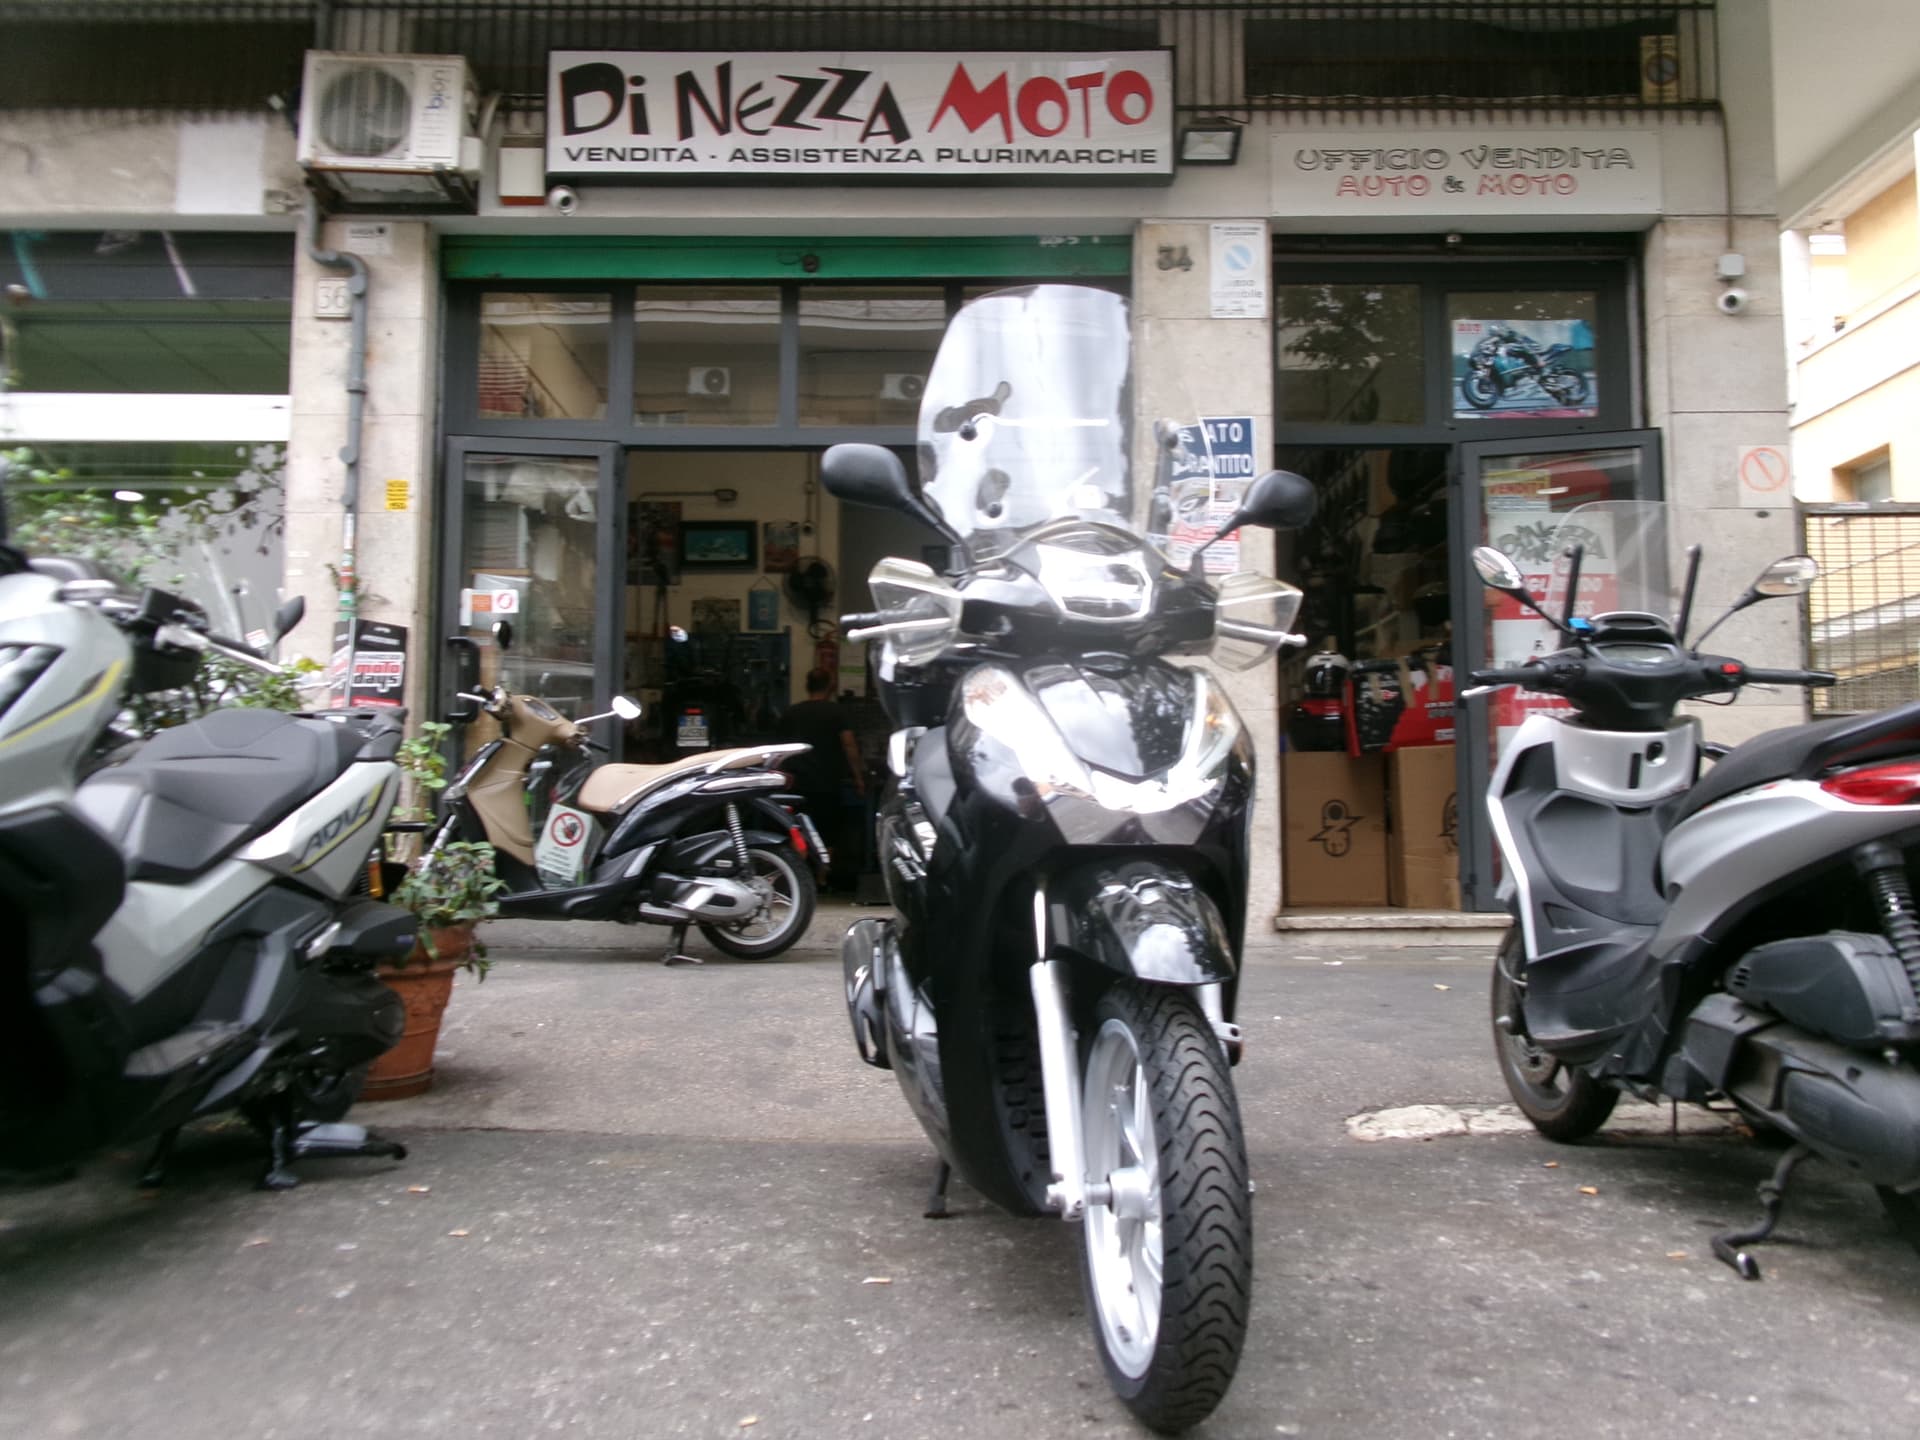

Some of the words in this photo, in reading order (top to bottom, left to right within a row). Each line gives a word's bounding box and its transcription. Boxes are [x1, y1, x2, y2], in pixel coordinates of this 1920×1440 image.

[928, 61, 1154, 144] MOTO
[565, 147, 698, 163] VENDITA
[728, 147, 924, 164] ASSISTENZA
[936, 148, 1158, 164] PLURIMARCHE
[1294, 148, 1451, 171] UFFICIO
[1459, 145, 1636, 170] VENDITA
[1336, 174, 1432, 196] AUTO
[1442, 175, 1465, 193] &
[1476, 173, 1579, 195] MOTO
[1156, 245, 1195, 272] 34
[317, 285, 350, 310] 36
